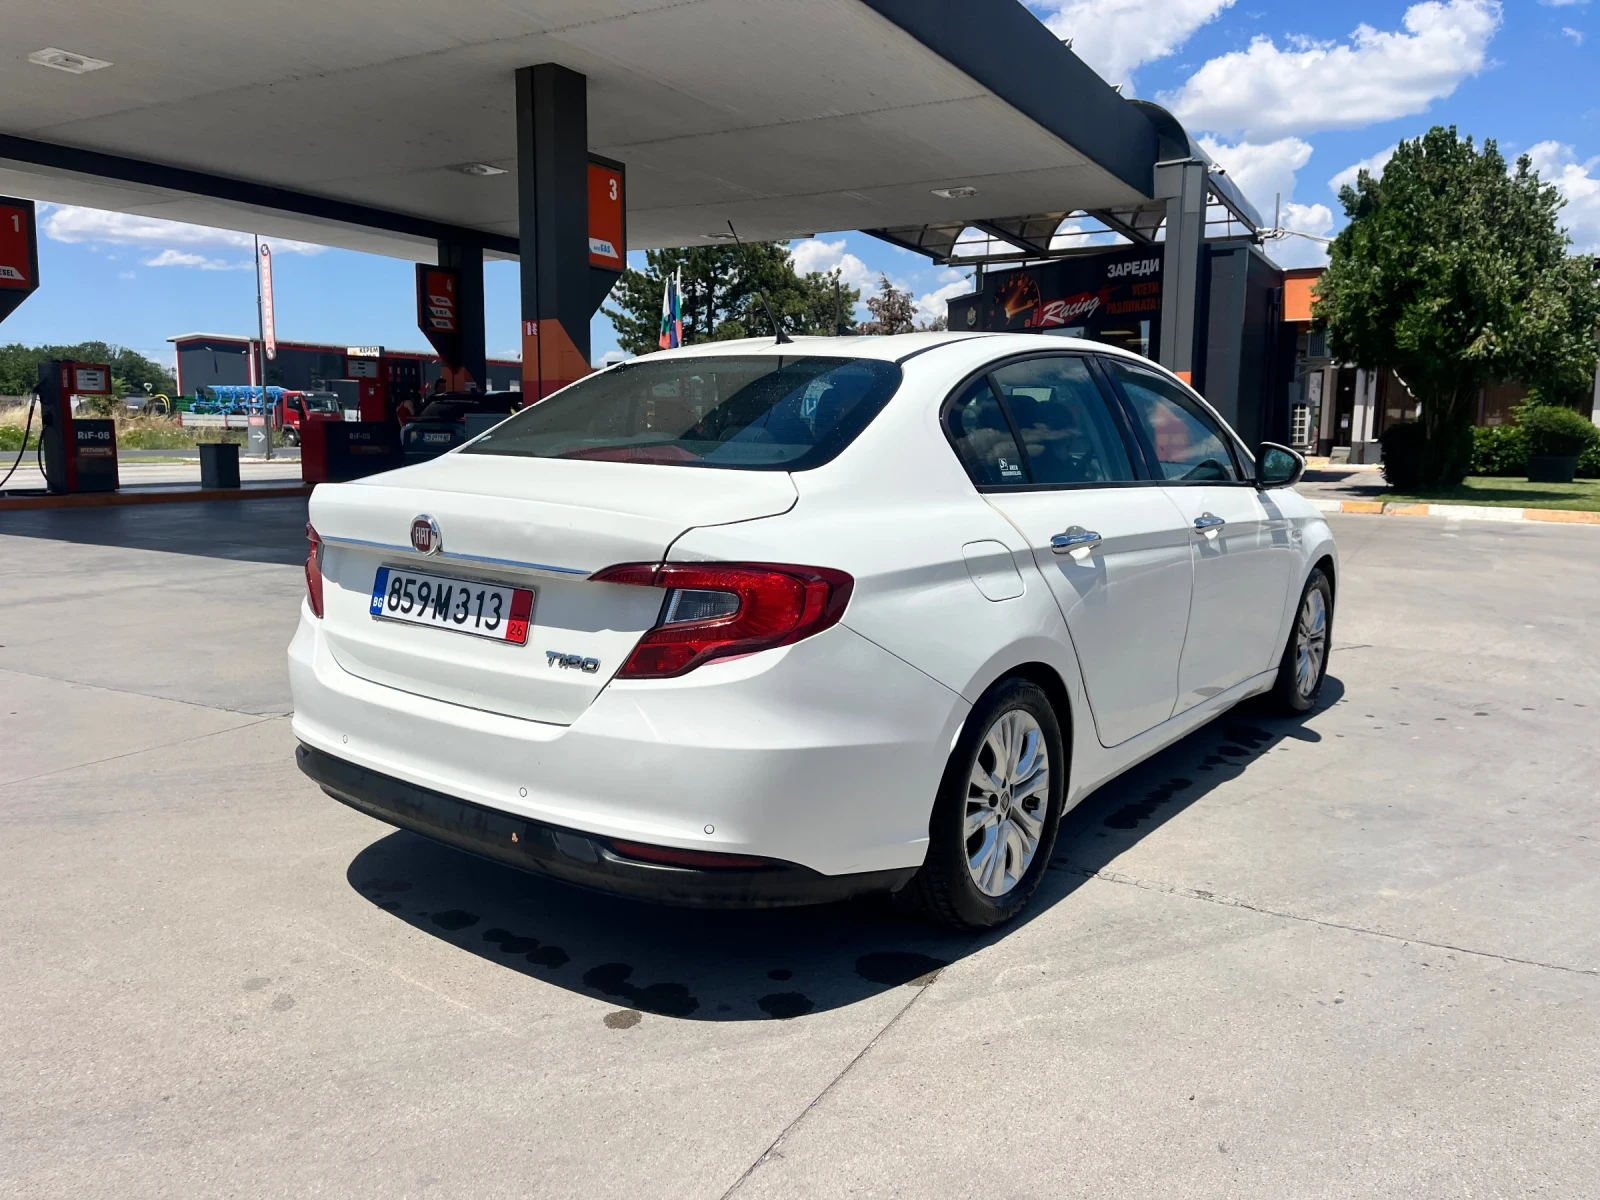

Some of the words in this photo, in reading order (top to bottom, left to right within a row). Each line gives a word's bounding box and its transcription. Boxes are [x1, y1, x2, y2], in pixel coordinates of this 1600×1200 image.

[609, 178, 618, 201] 3
[11, 214, 20, 233] 1
[1107, 258, 1160, 278] ЗАРЕДИ
[1131, 281, 1159, 296] УСЕТИ
[1040, 296, 1100, 326] Racing
[415, 526, 431, 546] FIAT
[372, 597, 384, 607] BG
[509, 622, 523, 636] 26
[545, 650, 601, 674] TIPO
